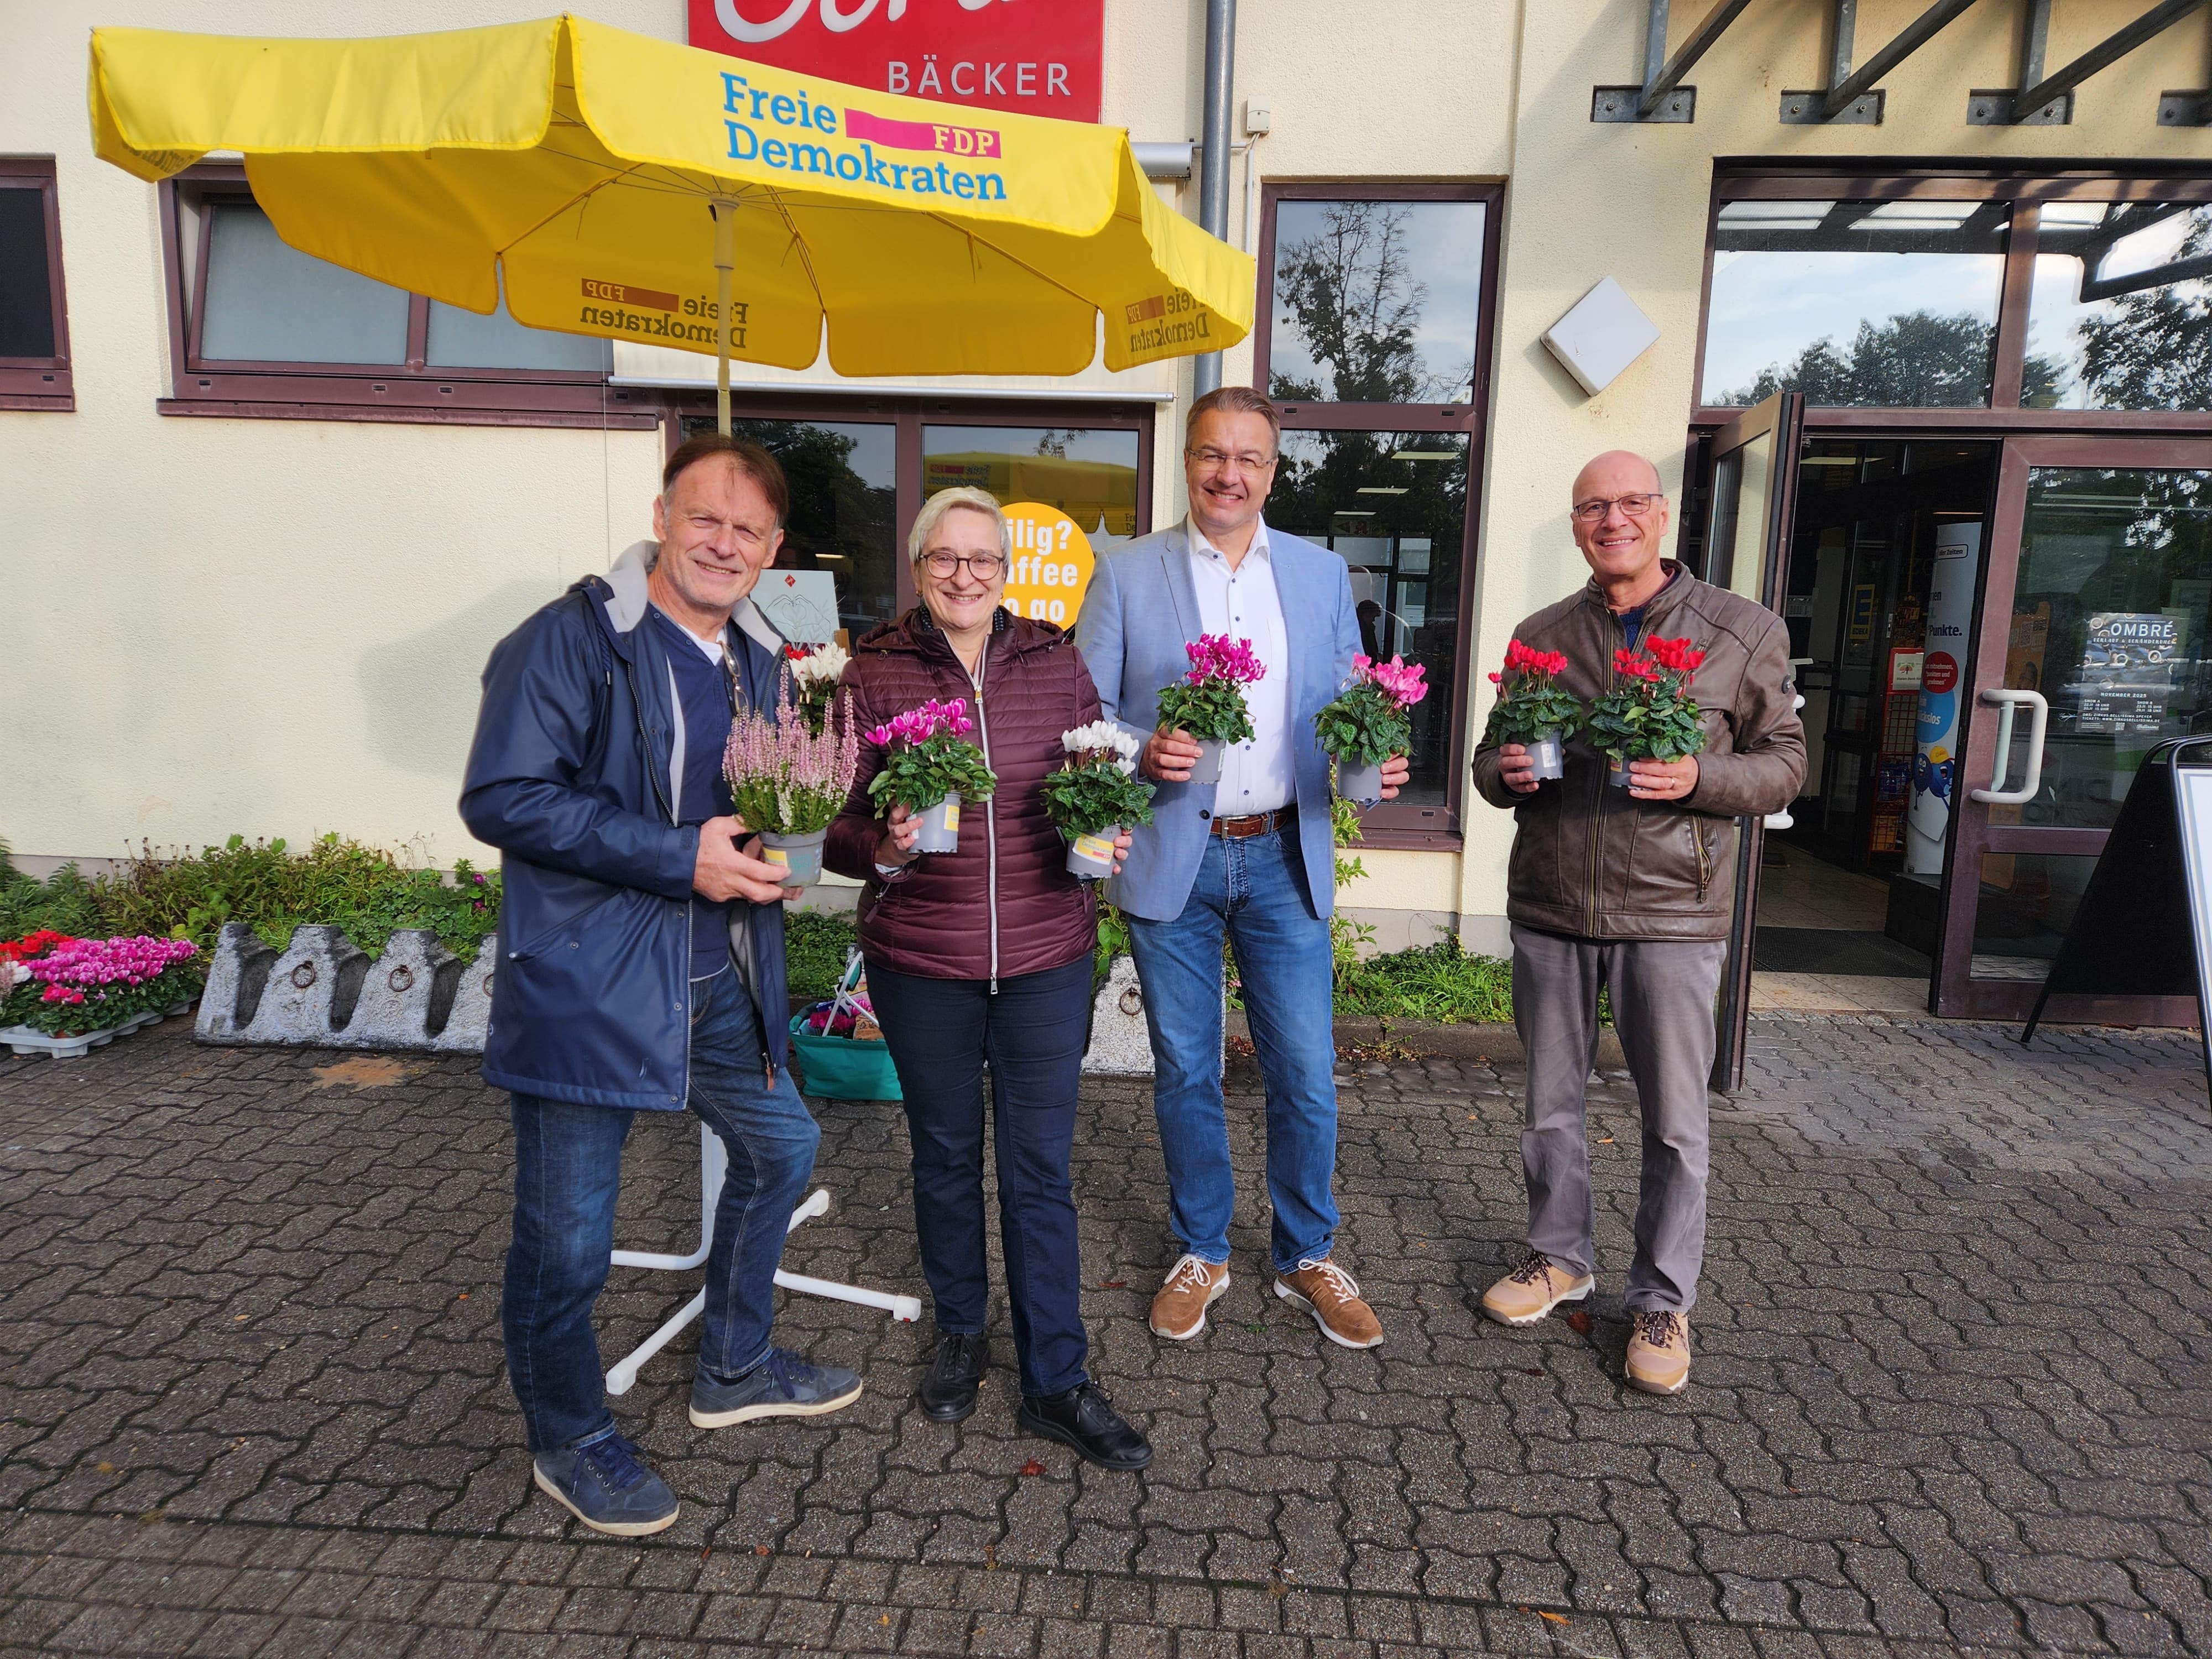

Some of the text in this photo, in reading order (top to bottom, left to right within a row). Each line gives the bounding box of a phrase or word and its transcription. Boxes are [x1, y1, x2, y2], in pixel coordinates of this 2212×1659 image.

[888, 54, 1071, 96] BÄCKER
[719, 71, 836, 134] Freie
[933, 126, 994, 155] FDP
[723, 119, 1007, 200] Demokraten
[1003, 598, 1065, 622] o go
[2111, 620, 2173, 637] OMBRÉ
